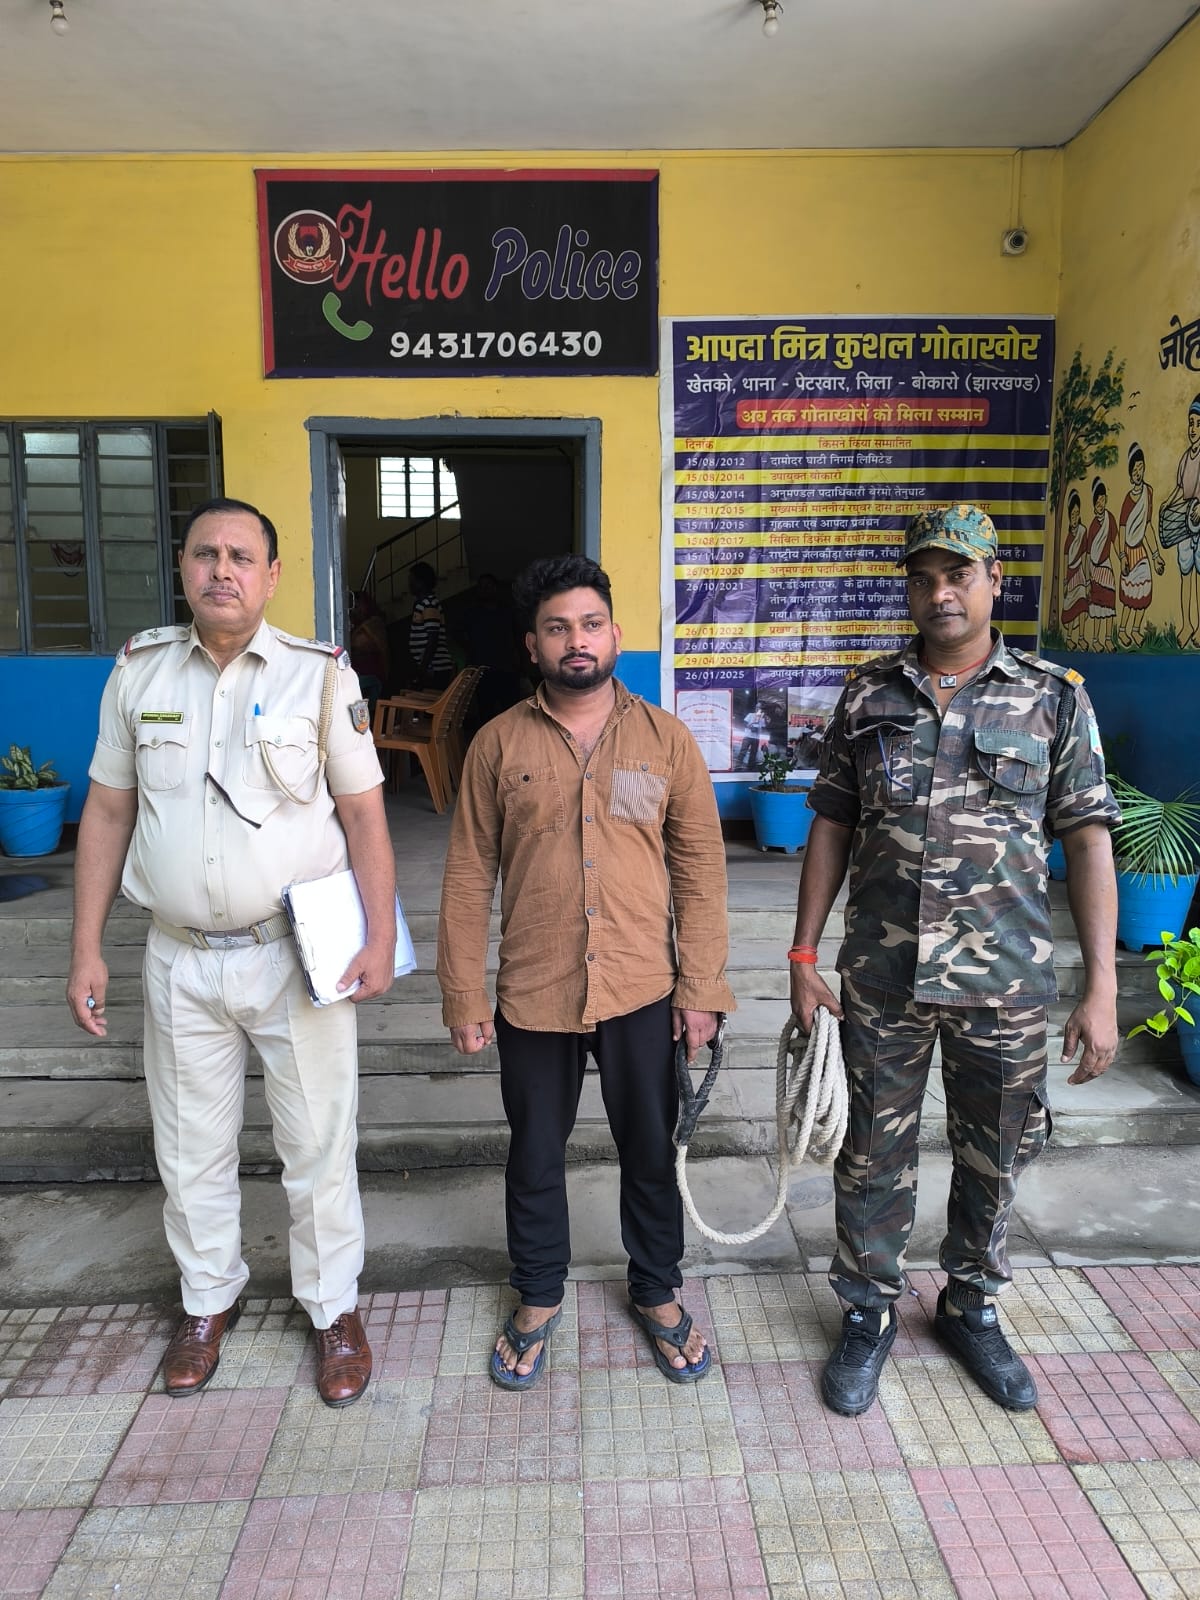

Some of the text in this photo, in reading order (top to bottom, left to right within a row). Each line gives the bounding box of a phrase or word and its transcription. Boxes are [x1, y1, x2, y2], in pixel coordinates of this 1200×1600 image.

[333, 200, 641, 306] Hello Police
[390, 330, 602, 358] 9431706430
[686, 324, 1042, 370] आपदा मित्र कुशल गोताखोर
[686, 373, 736, 394] खेतको,
[742, 377, 777, 392] थाना
[795, 372, 850, 392] पेटरवार,
[856, 371, 893, 390] जिला
[912, 371, 960, 390] बोकारो
[965, 373, 1041, 392] (झारखण्ड)
[741, 403, 985, 423] अब तक गोताखोरों को मिला सम्मान
[685, 438, 714, 449] दिनांक
[818, 436, 913, 448] किसने किया सम्मानित
[686, 457, 745, 466] 15/08/2012
[770, 454, 803, 467] दामोदर
[830, 453, 854, 464] निगम
[856, 453, 893, 464] लिमिटेड
[686, 490, 745, 499] 15/08/2014
[818, 486, 866, 497] पदाधिकारी
[820, 519, 849, 528] आपदा
[686, 582, 744, 591] 26/10/2021
[685, 670, 745, 680] 26/01/2025
